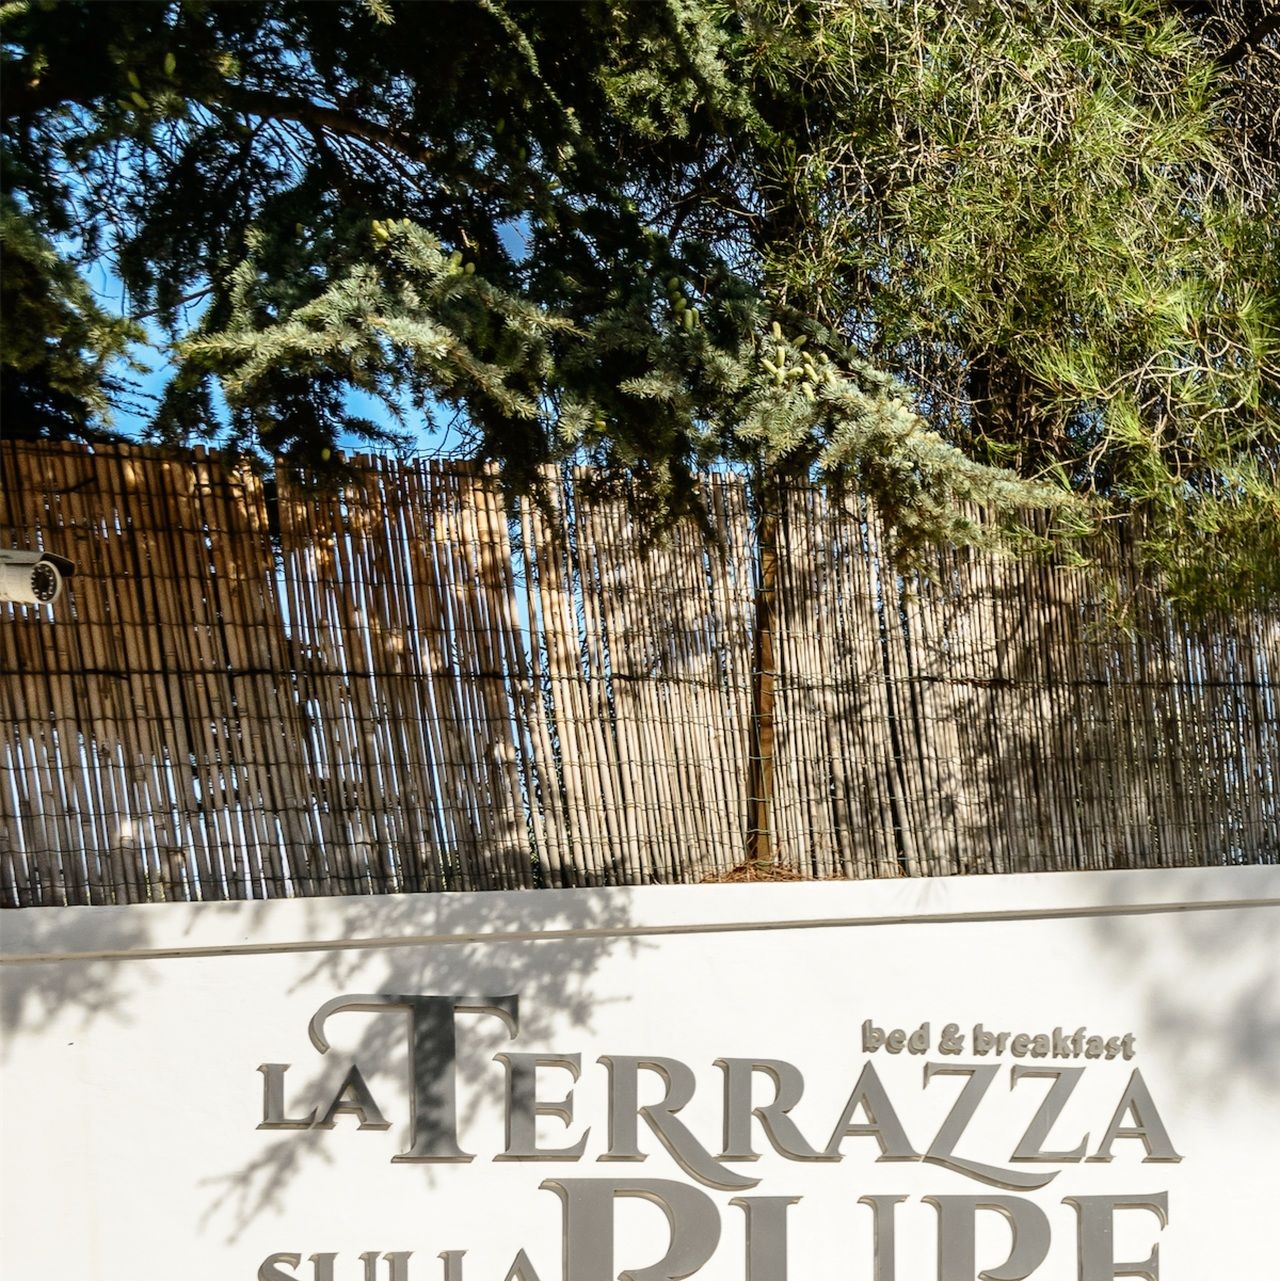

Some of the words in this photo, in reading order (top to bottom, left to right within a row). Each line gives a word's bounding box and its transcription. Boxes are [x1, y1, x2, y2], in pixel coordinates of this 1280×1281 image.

[862, 1019, 931, 1054] bed
[938, 1022, 966, 1056] &
[972, 1022, 1137, 1061] breakfast
[256, 1062, 393, 1131] LA
[308, 993, 1186, 1192] TERRAZZA
